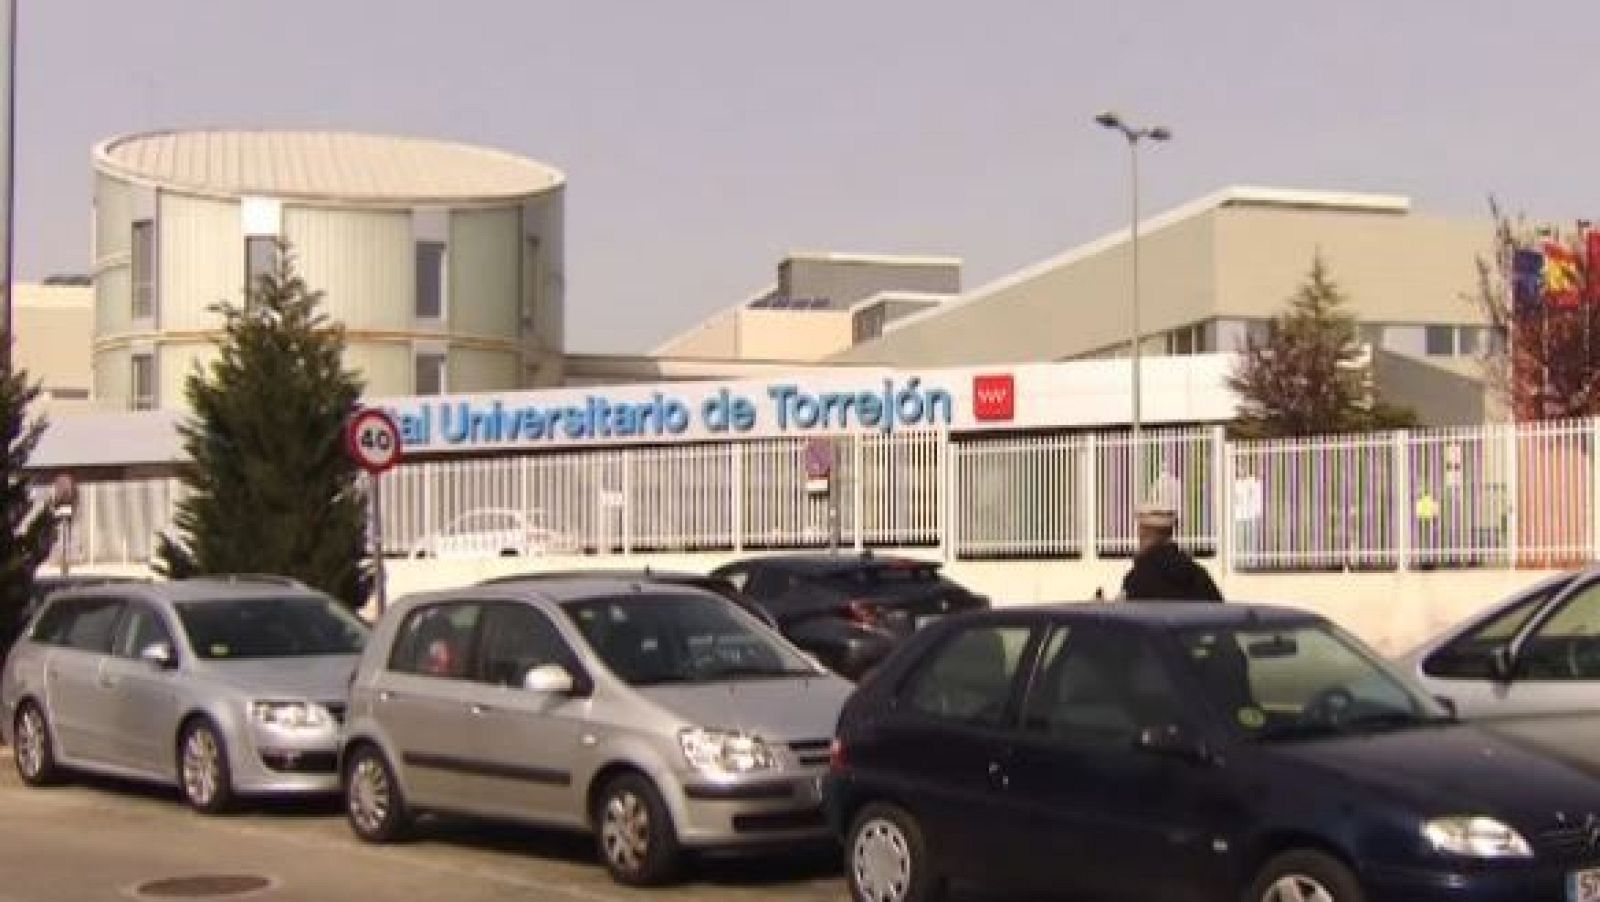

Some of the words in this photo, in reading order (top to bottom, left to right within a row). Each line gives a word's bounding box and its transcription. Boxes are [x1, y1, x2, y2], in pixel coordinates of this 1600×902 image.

[439, 392, 689, 445] Universitario
[701, 387, 757, 432] de
[766, 376, 953, 434] Torrejón
[360, 428, 390, 451] 40
